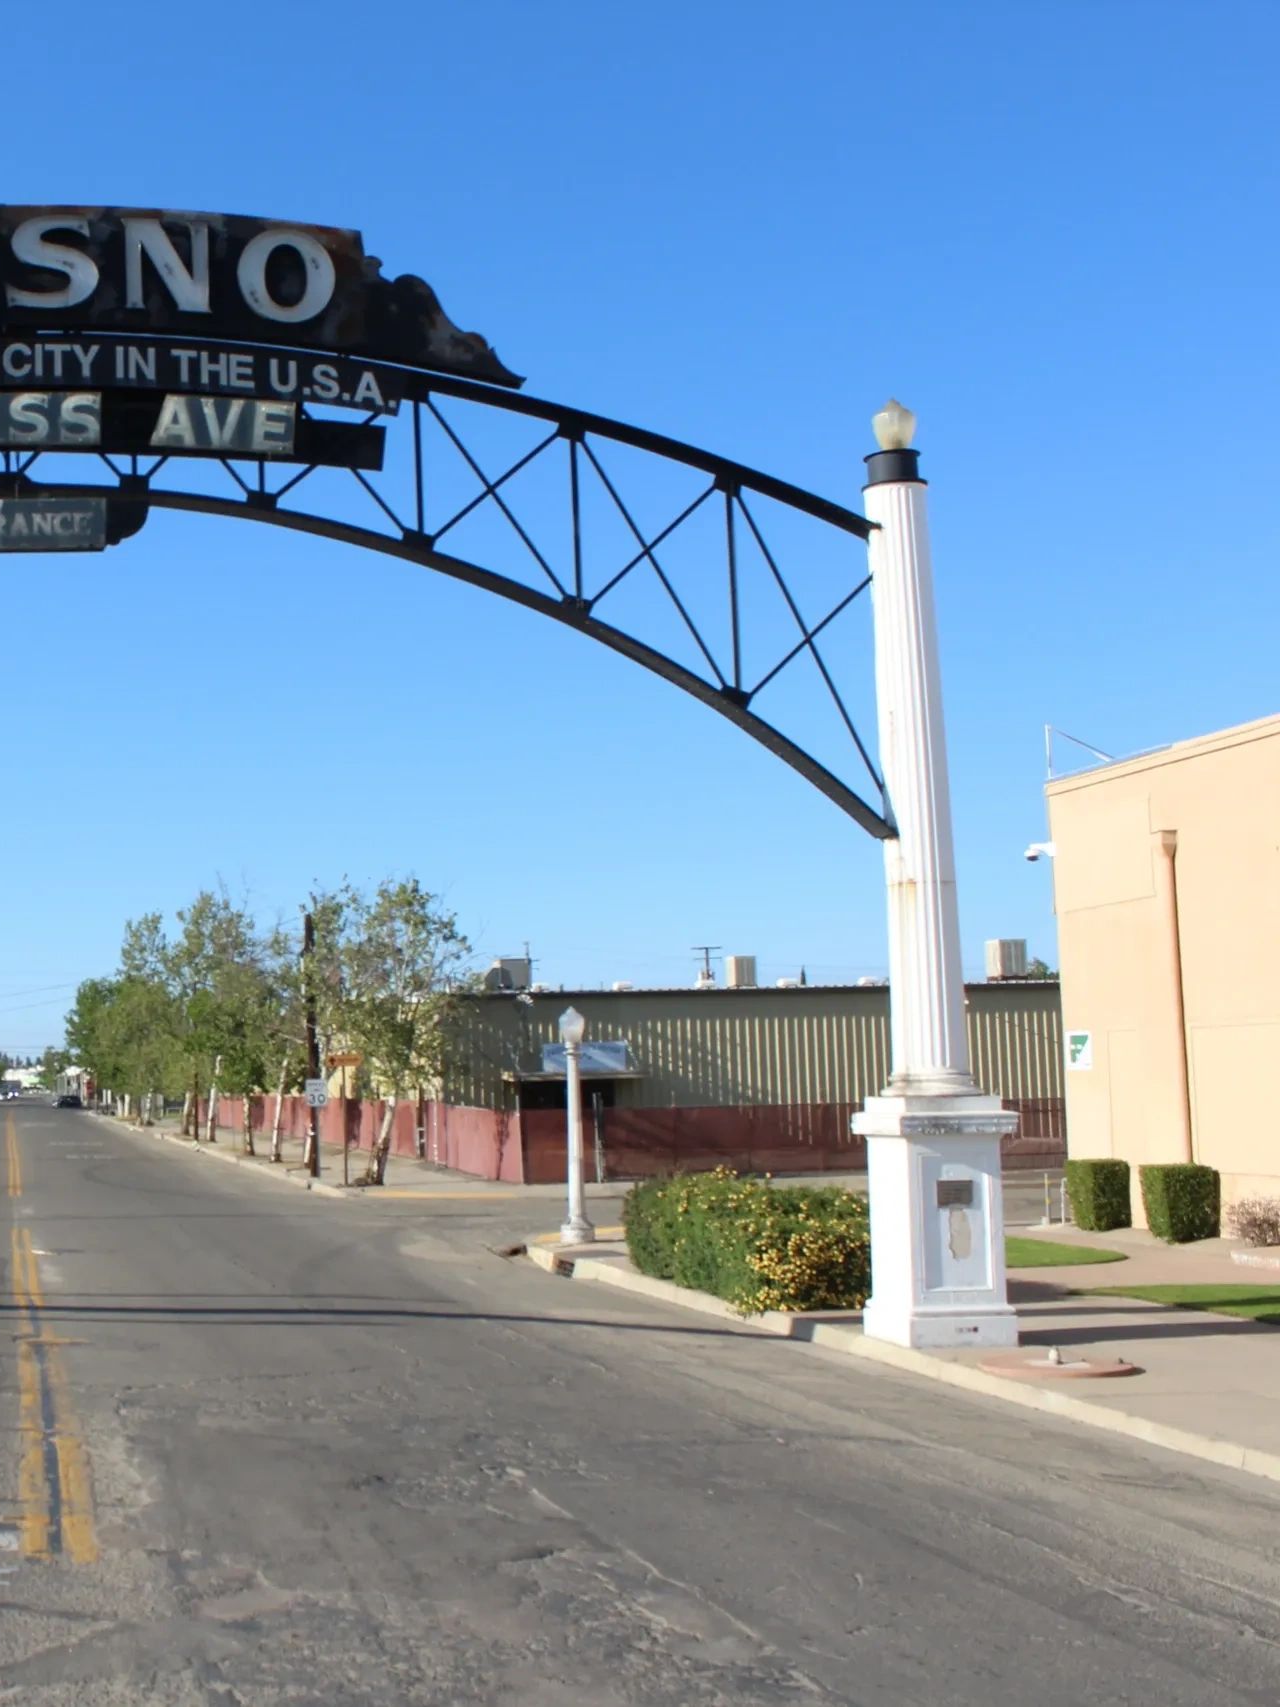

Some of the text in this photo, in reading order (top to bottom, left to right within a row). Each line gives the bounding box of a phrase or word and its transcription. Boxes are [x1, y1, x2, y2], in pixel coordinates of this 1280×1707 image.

[2, 343, 102, 378] CITY
[114, 345, 156, 380] IN
[170, 348, 255, 391] THE
[269, 358, 398, 409] U.S.A.
[150, 394, 295, 455] AVE
[308, 1094, 325, 1104] 30
